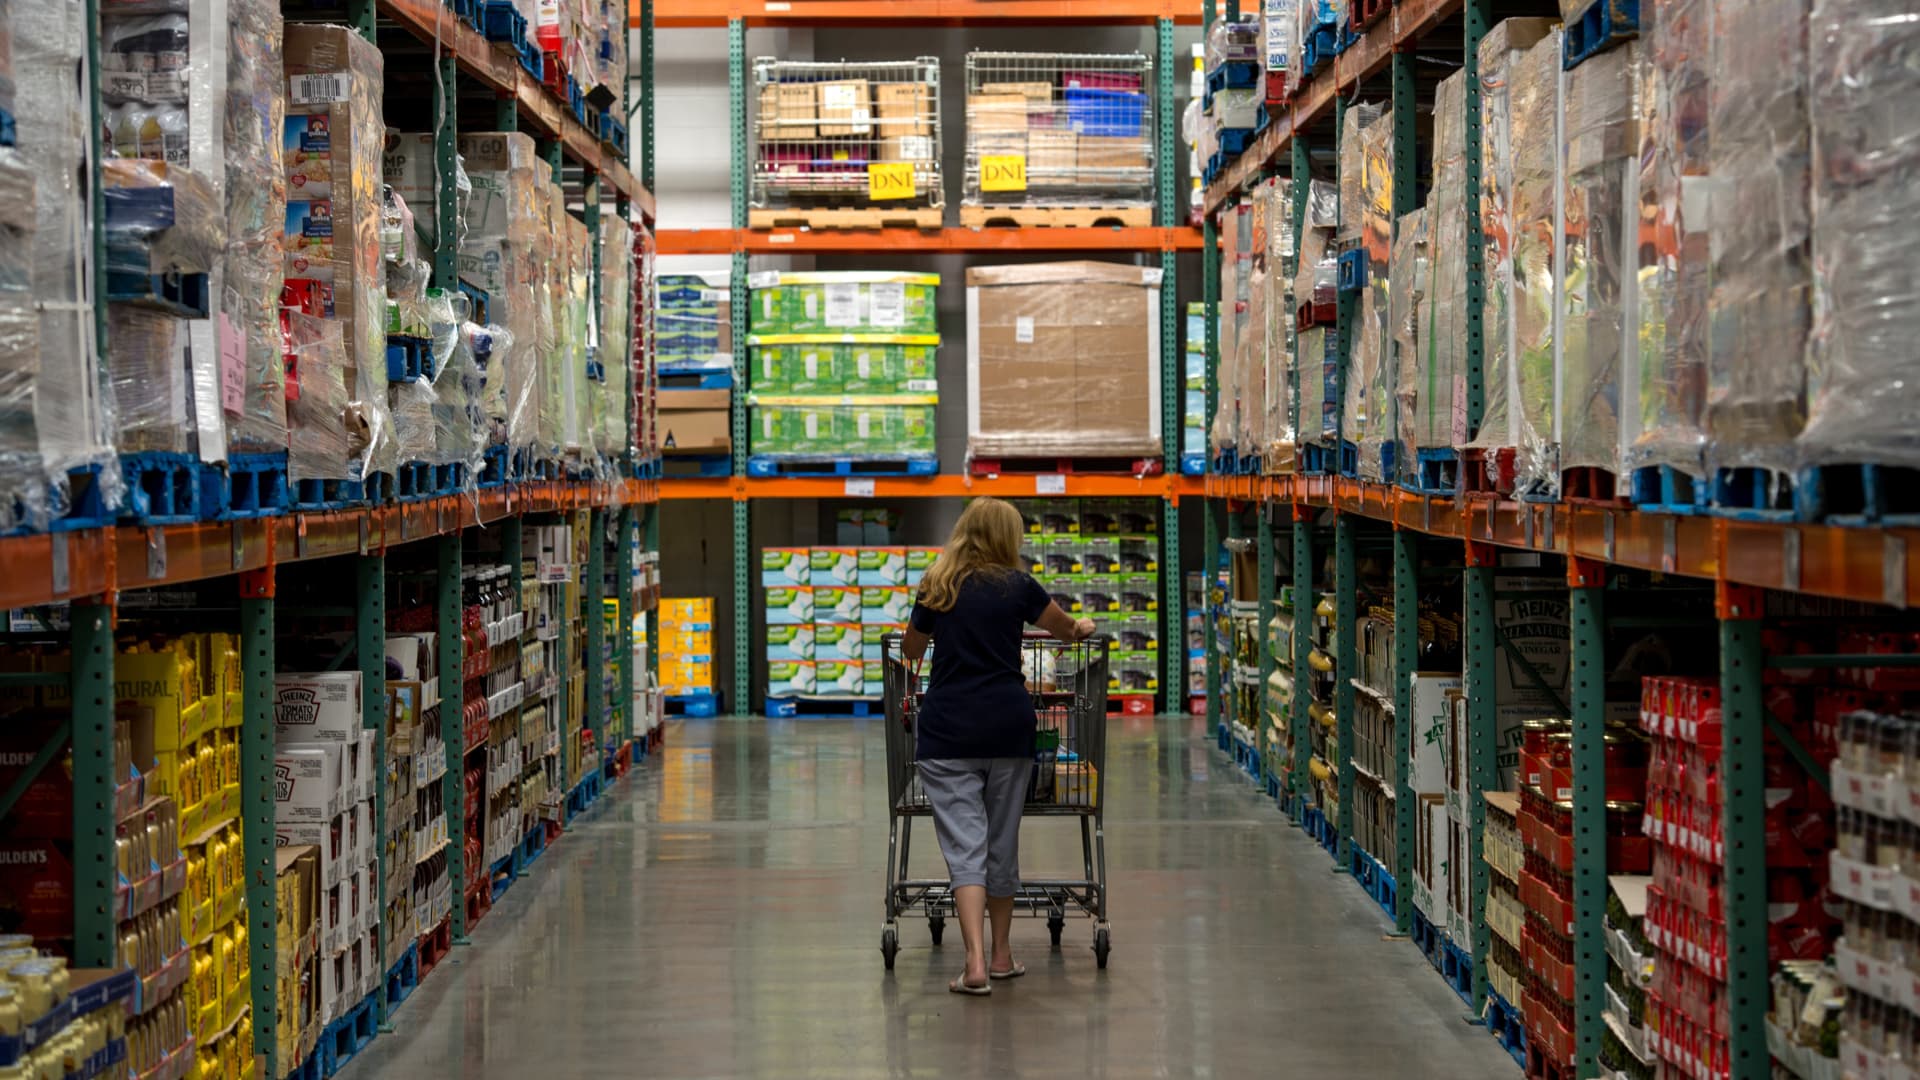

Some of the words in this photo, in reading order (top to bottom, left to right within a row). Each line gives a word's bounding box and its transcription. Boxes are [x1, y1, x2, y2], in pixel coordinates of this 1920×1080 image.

[1269, 54, 1287, 65] 400
[984, 164, 1023, 182] DNI
[873, 171, 912, 190] DNI
[1517, 600, 1564, 619] HEINZ
[283, 691, 312, 702] HEINZ
[282, 704, 314, 714] TOMATO
[280, 713, 314, 722] KETCHUP
